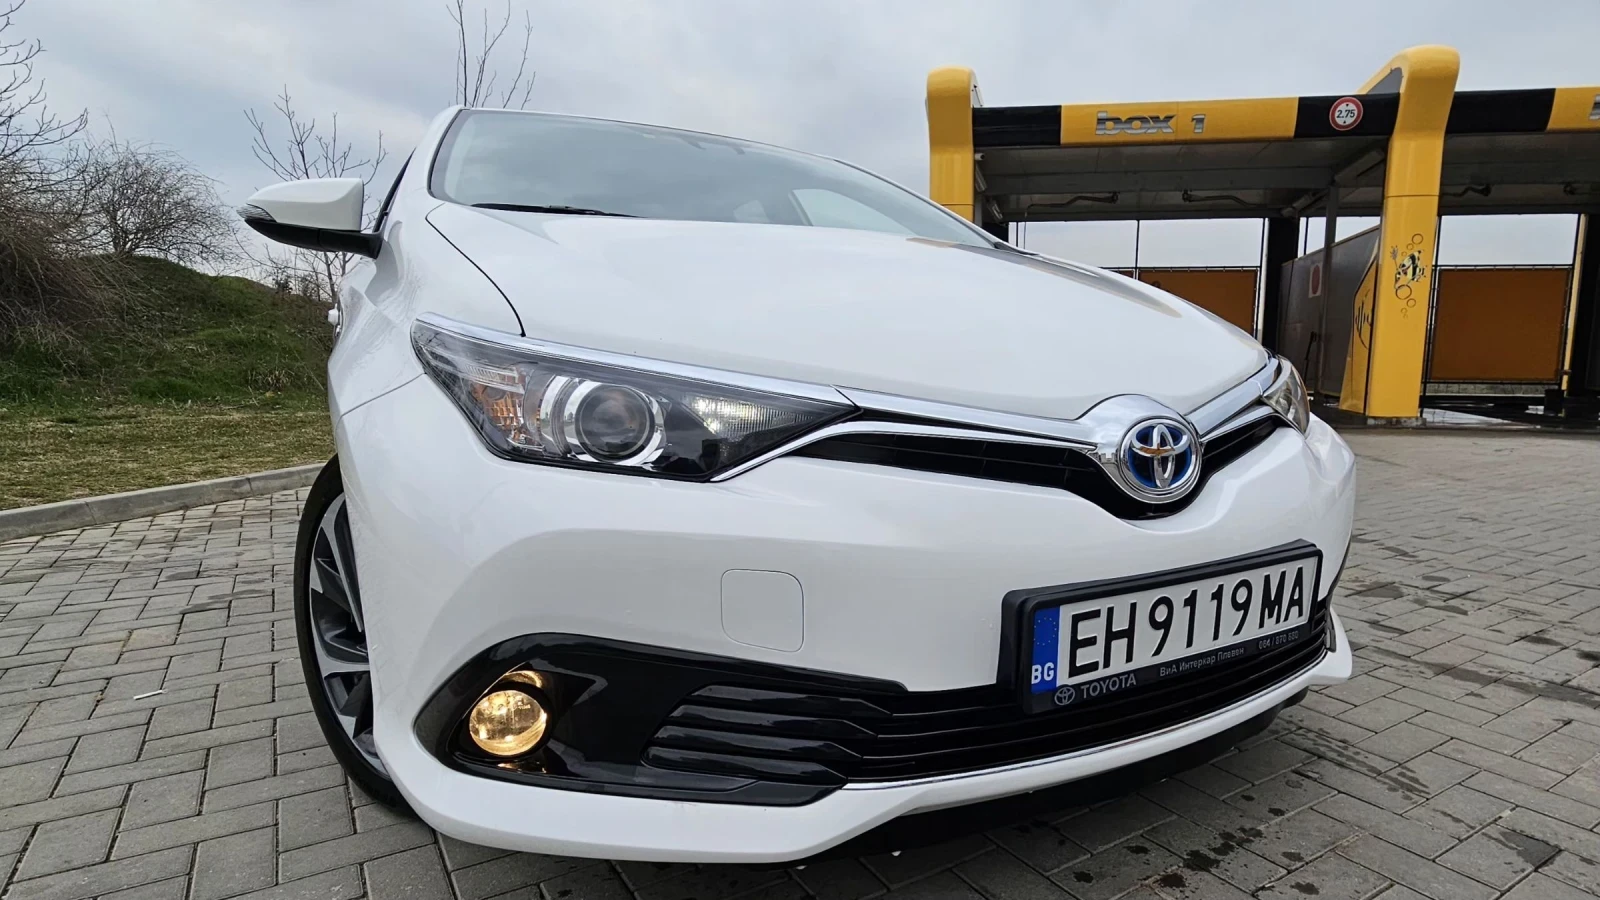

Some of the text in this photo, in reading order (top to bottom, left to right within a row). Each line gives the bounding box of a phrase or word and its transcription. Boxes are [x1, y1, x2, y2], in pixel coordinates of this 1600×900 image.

[1095, 111, 1206, 135] box 1
[1336, 109, 1356, 119] 2.75
[1031, 662, 1055, 684] BG
[1179, 655, 1216, 672] Интеркар
[1081, 673, 1137, 699] TOYOTA
